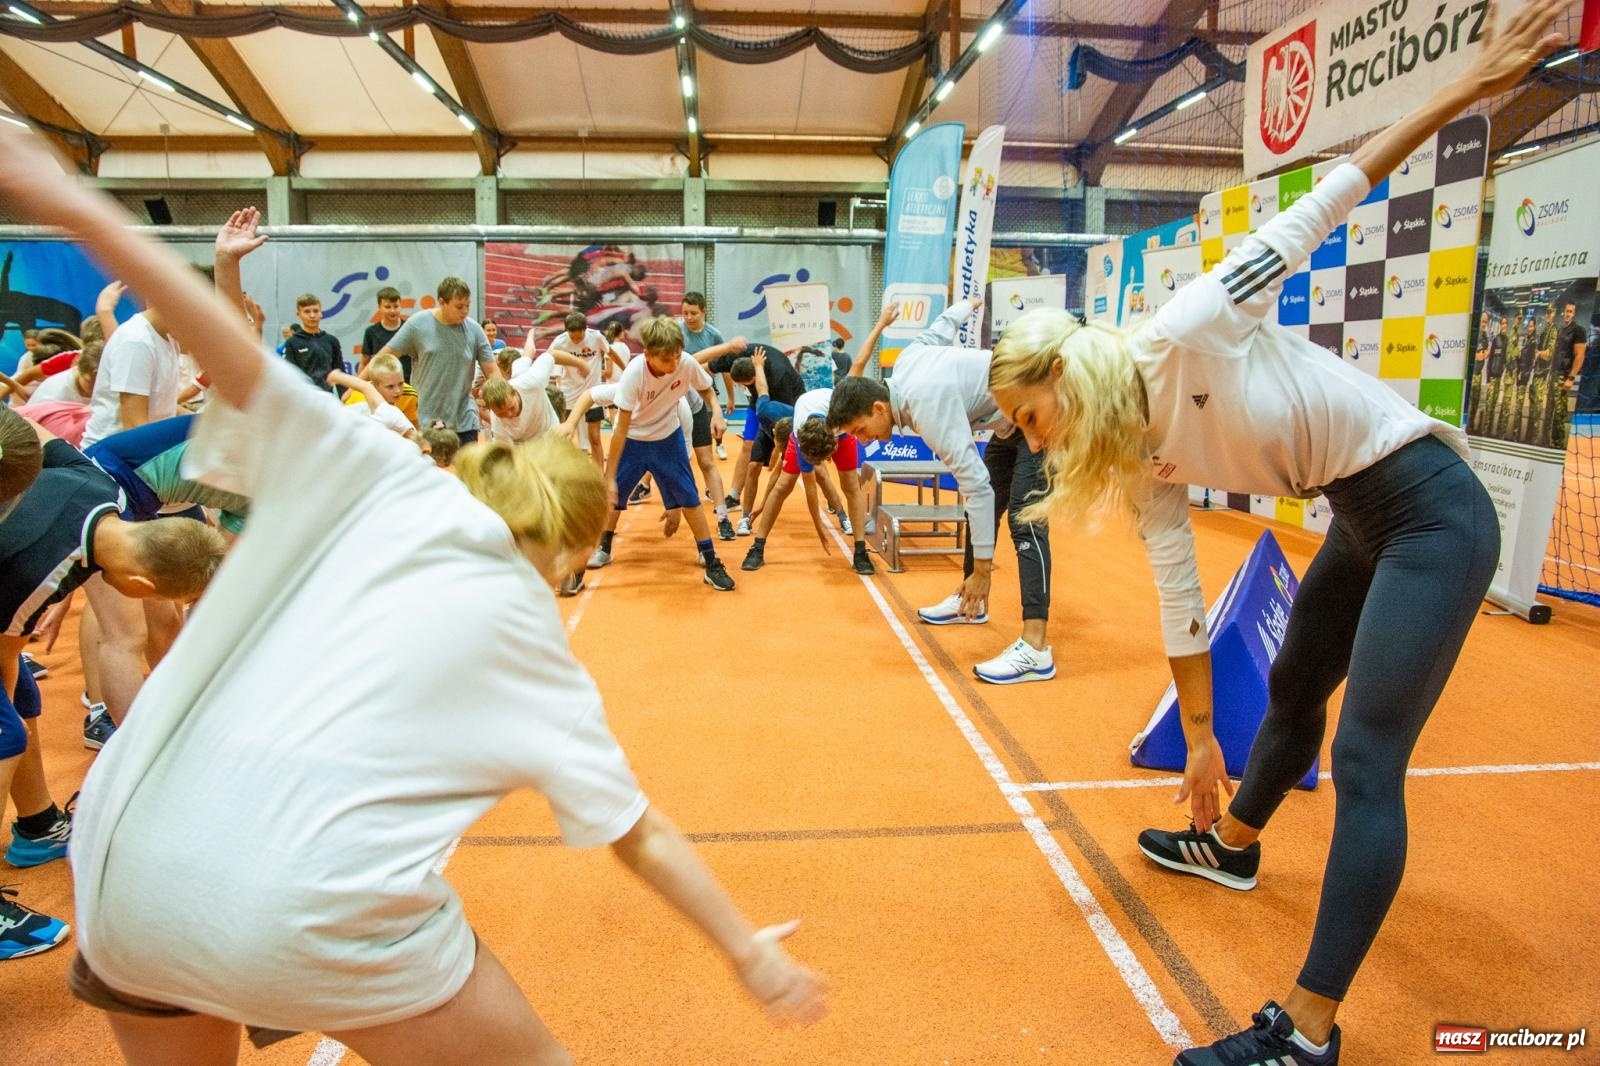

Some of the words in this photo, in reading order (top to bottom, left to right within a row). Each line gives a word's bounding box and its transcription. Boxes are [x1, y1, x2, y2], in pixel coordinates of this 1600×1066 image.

[1329, 0, 1408, 56] MIASTO
[1326, 0, 1489, 108] Racibórz
[1410, 151, 1434, 165] ZSOMS
[1453, 205, 1479, 218] ZSOMS
[1538, 199, 1569, 219] ZSOMS
[1520, 250, 1589, 274] Graniczna
[1403, 278, 1425, 288] ZSOMS
[1442, 339, 1466, 350] ZSOMS
[881, 441, 918, 459] Śląskie.
[1473, 460, 1535, 485] smsraciborz.pl
